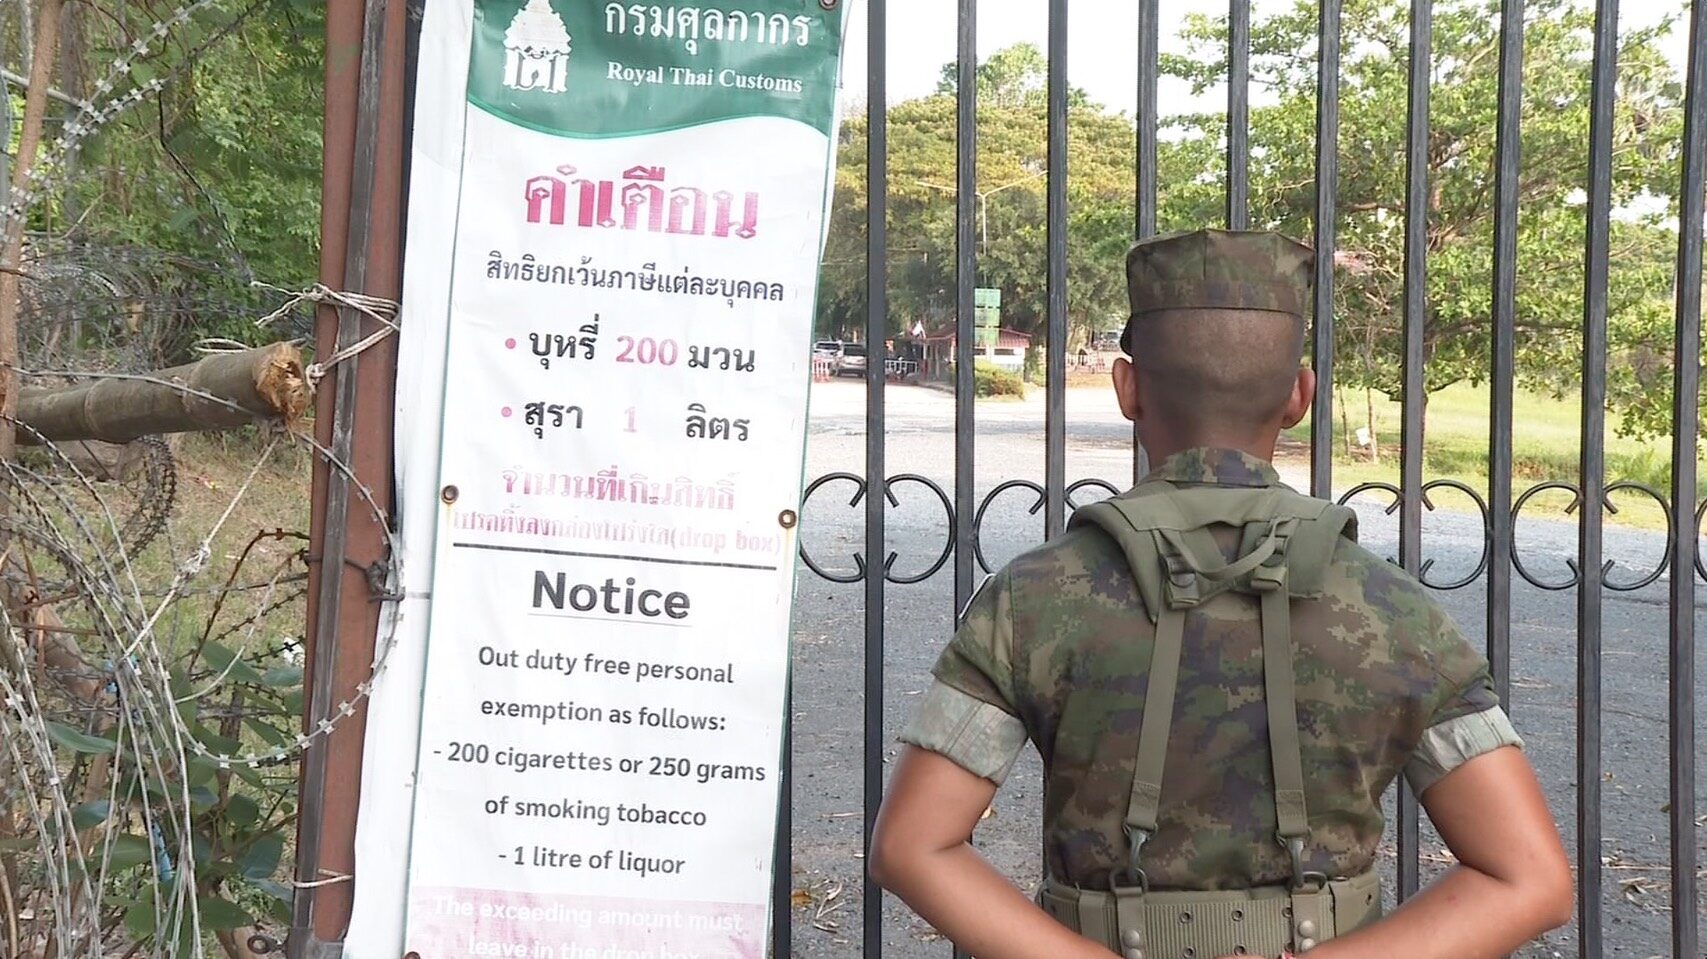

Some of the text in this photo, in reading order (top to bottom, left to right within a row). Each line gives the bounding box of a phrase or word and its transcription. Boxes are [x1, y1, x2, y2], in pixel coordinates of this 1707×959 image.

[604, 3, 812, 56] กรมศุลกากร
[607, 61, 804, 93] Royal Thai Customs
[525, 164, 759, 239] คำเตือน
[486, 250, 784, 308] สิทธิยกเว้นภาษีแต่ละบุคคล
[529, 313, 756, 373] บุหรี่ 200 มวน
[524, 401, 751, 442] สุรา 1 ลิตร
[532, 570, 691, 619] Notice
[478, 646, 734, 683] Out duty free personal
[481, 699, 726, 731] exemption as follows:
[447, 741, 489, 764] 200
[495, 746, 613, 772] cigarettes
[619, 758, 644, 774] or
[648, 756, 691, 777] 250
[696, 763, 766, 783] grams
[484, 796, 707, 826] of smoking tobacco
[514, 846, 525, 866] 1
[533, 846, 582, 868] litre
[588, 850, 614, 869] of
[618, 850, 686, 878] liquor
[433, 896, 744, 931] The exceeding amount must
[468, 933, 528, 957] leave
[534, 939, 554, 959] in
[560, 941, 597, 959] the
